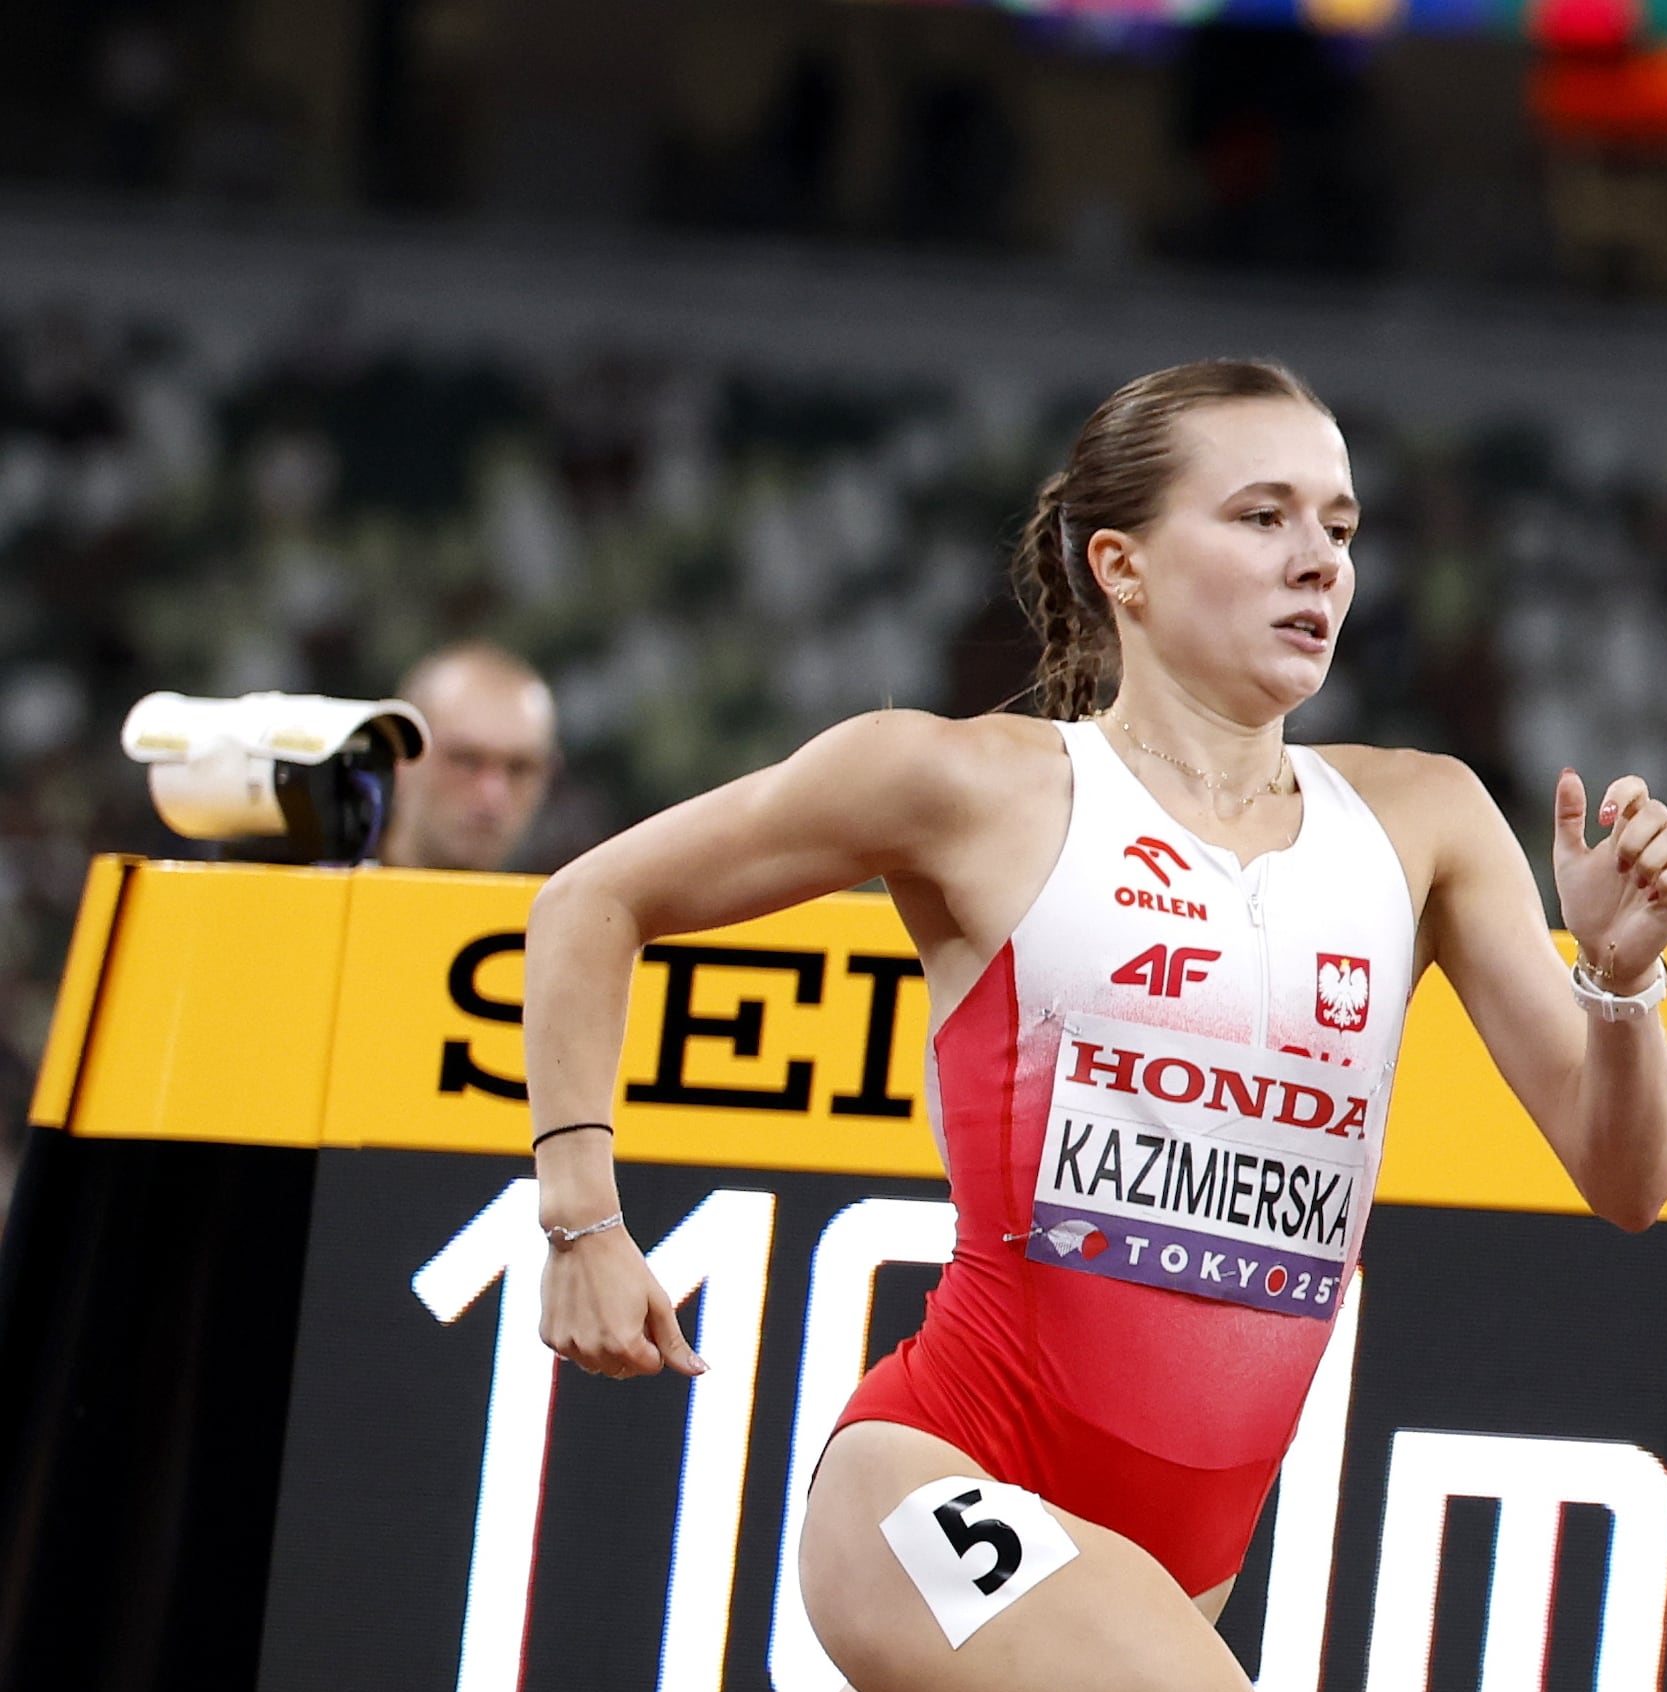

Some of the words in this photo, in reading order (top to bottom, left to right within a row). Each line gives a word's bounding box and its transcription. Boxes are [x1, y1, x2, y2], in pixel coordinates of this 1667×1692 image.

[1114, 886, 1208, 922] ORLEN
[1109, 943, 1223, 998] 4F
[1065, 1040, 1369, 1141] HONDA
[1052, 1119, 1354, 1249] KAZIMIERSKA
[932, 1488, 1023, 1597] 5
